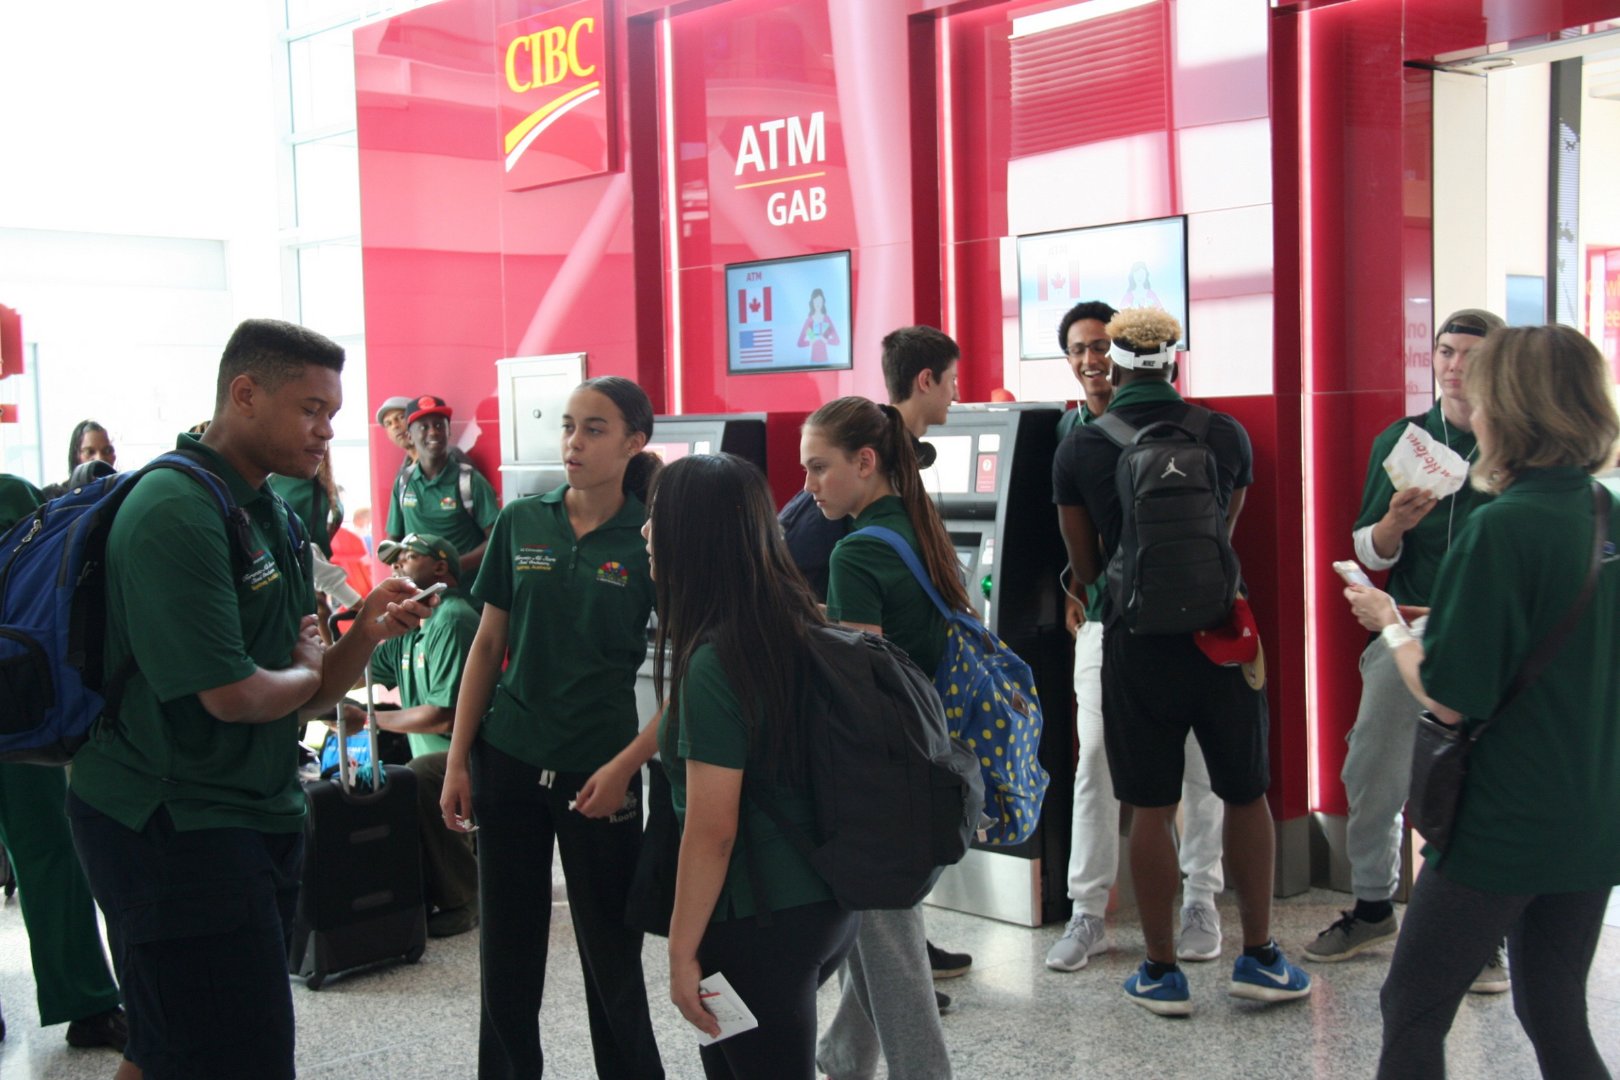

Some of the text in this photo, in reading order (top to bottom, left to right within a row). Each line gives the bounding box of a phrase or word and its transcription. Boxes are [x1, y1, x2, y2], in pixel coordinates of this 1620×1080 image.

[505, 17, 595, 93] CIBC
[735, 111, 825, 176] ATM
[767, 186, 827, 226] GAB
[746, 271, 762, 281] ATM
[609, 810, 637, 824] Roots
